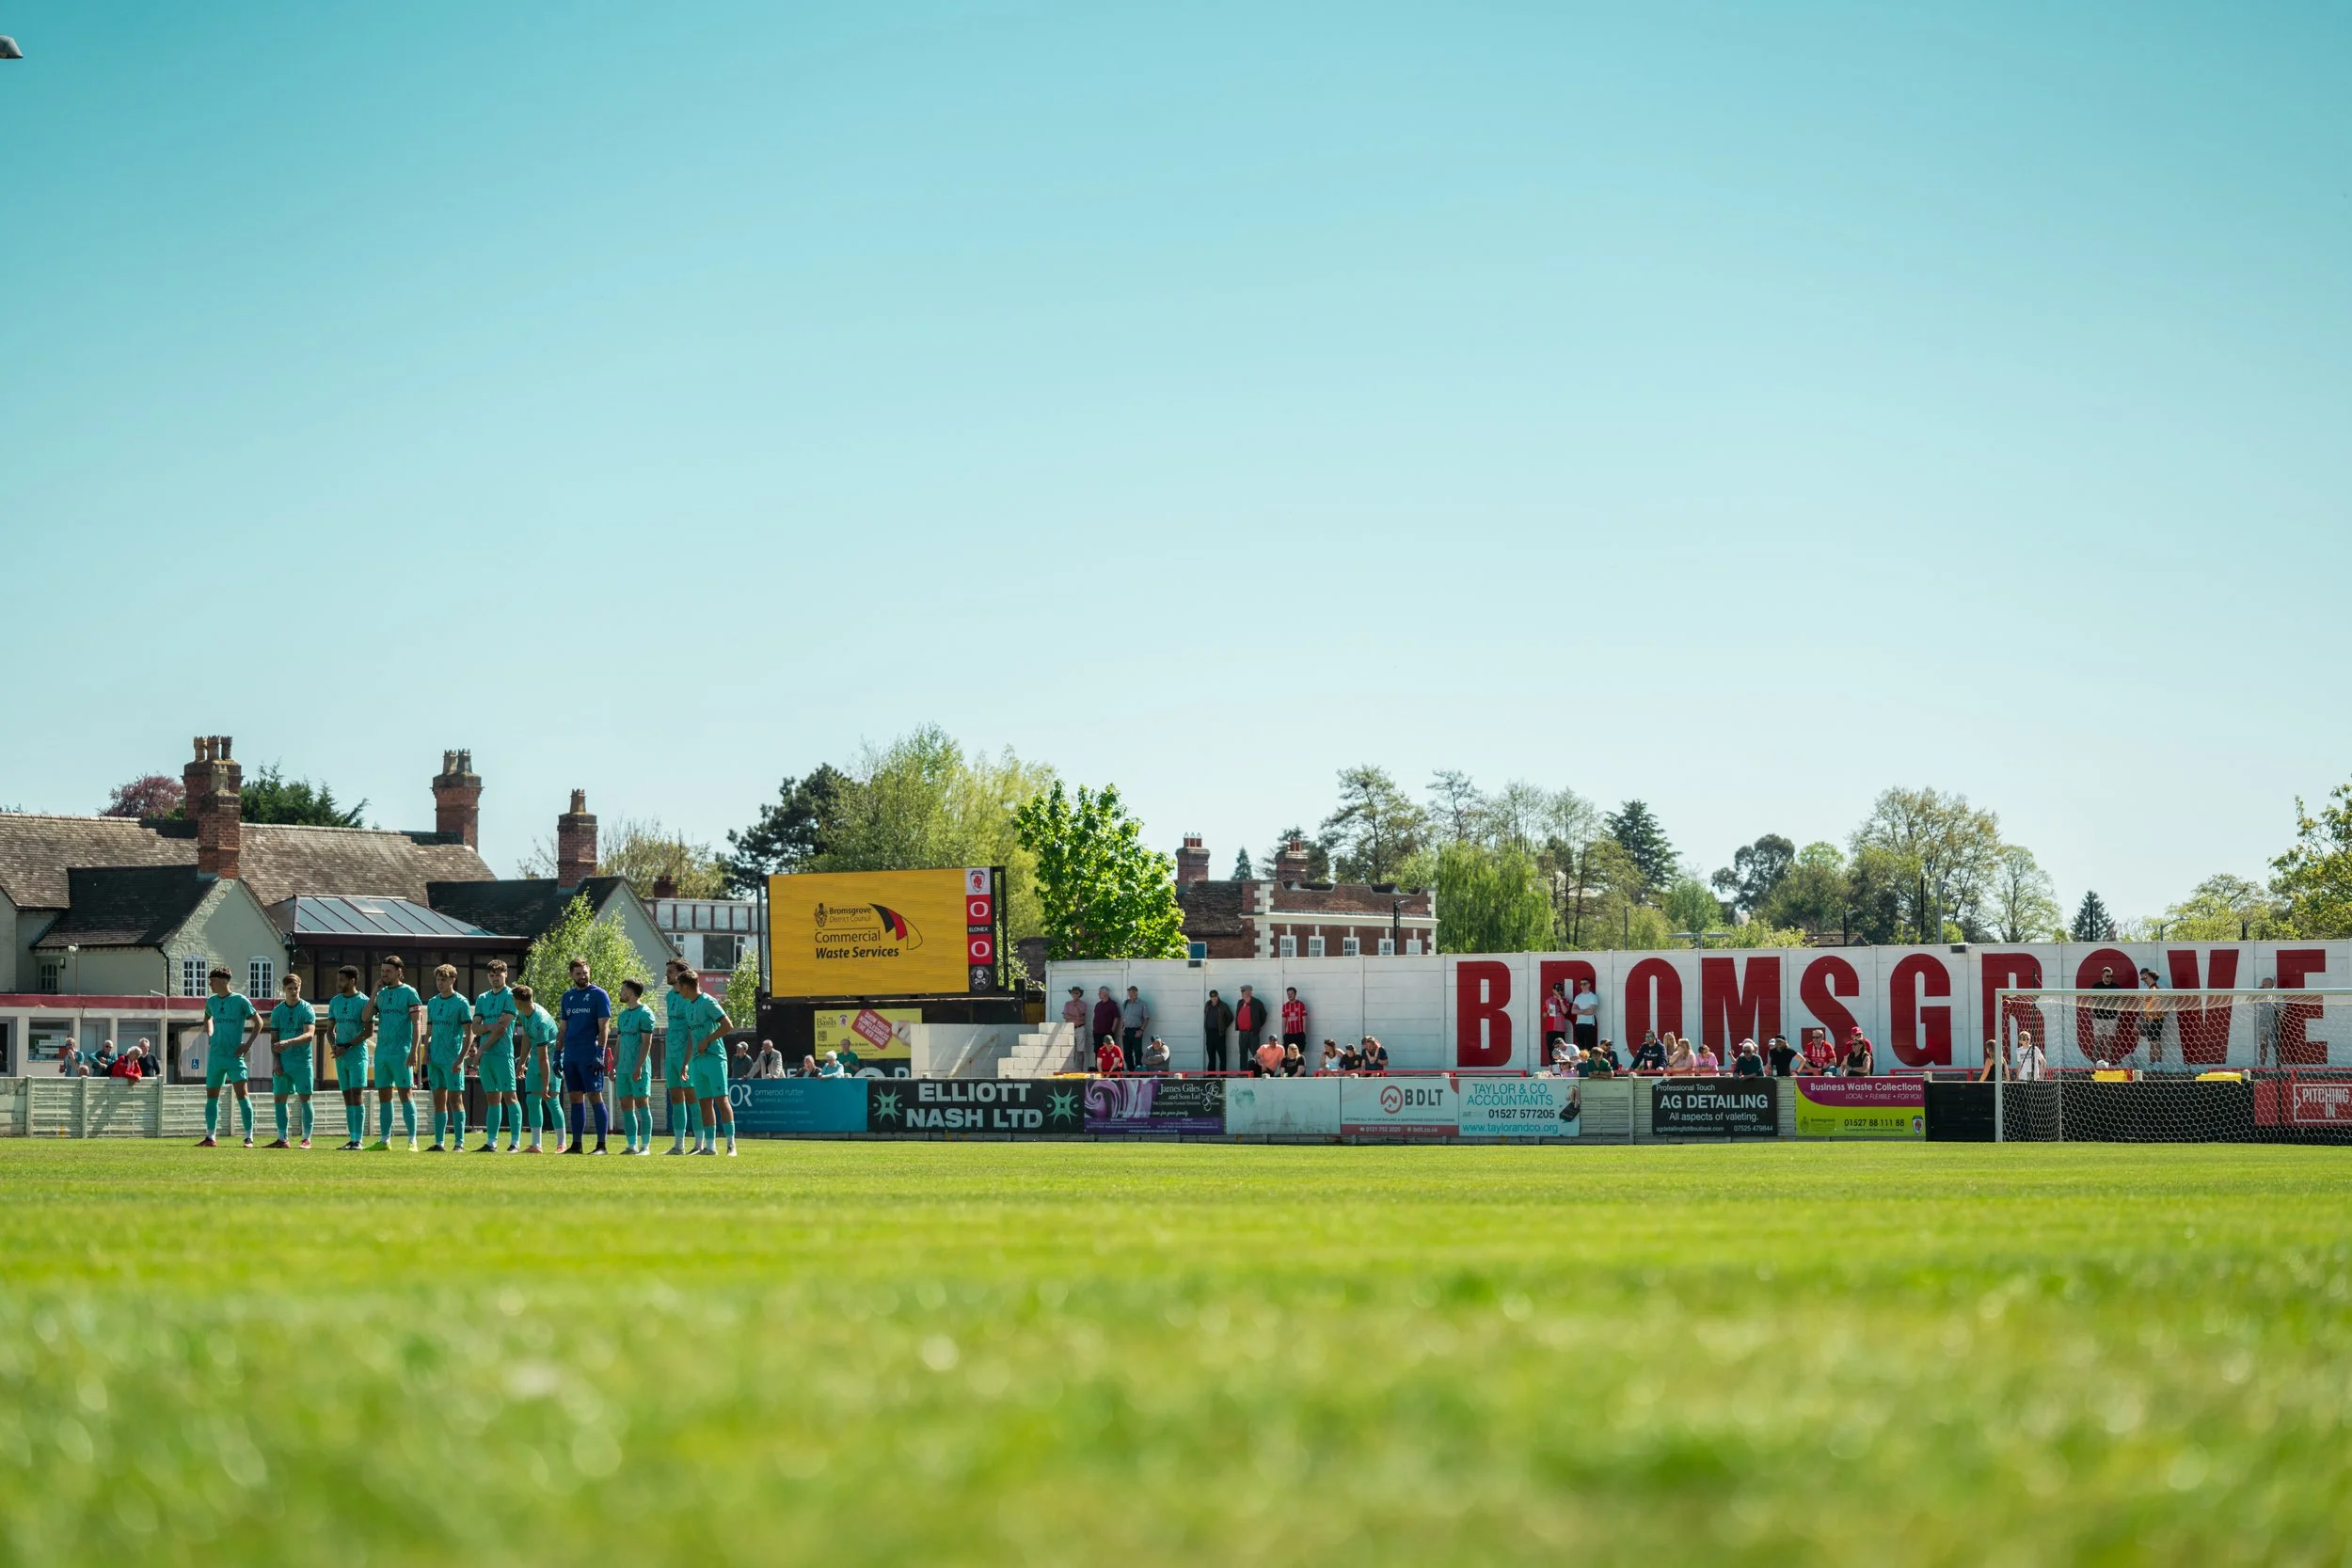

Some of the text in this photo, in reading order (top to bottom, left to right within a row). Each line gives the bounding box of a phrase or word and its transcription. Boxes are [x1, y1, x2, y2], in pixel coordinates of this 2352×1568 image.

[815, 929, 881, 943] Commercial
[815, 945, 899, 959] Waste Services
[918, 1083, 1031, 1101] ELLIOTT
[1158, 1084, 1200, 1095] James Giles
[1472, 1083, 1548, 1094] TAYLOR & CO
[1810, 1082, 1922, 1091] Business Waste Collections
[728, 1085, 753, 1107] OR
[1405, 1089, 1443, 1106] BDLT
[1467, 1095, 1554, 1106] ACCOUNTANTS
[1660, 1094, 1768, 1109] AG DETAILING
[2302, 1088, 2349, 1103] PITCHING
[1488, 1109, 1518, 1118] 01527
[1519, 1109, 1555, 1118] 577205
[1669, 1112, 1759, 1123] All aspects of valeting.
[2326, 1103, 2335, 1118] IN
[906, 1108, 1043, 1128] NASH LTD
[1462, 1123, 1559, 1133] www.taylorandco.org
